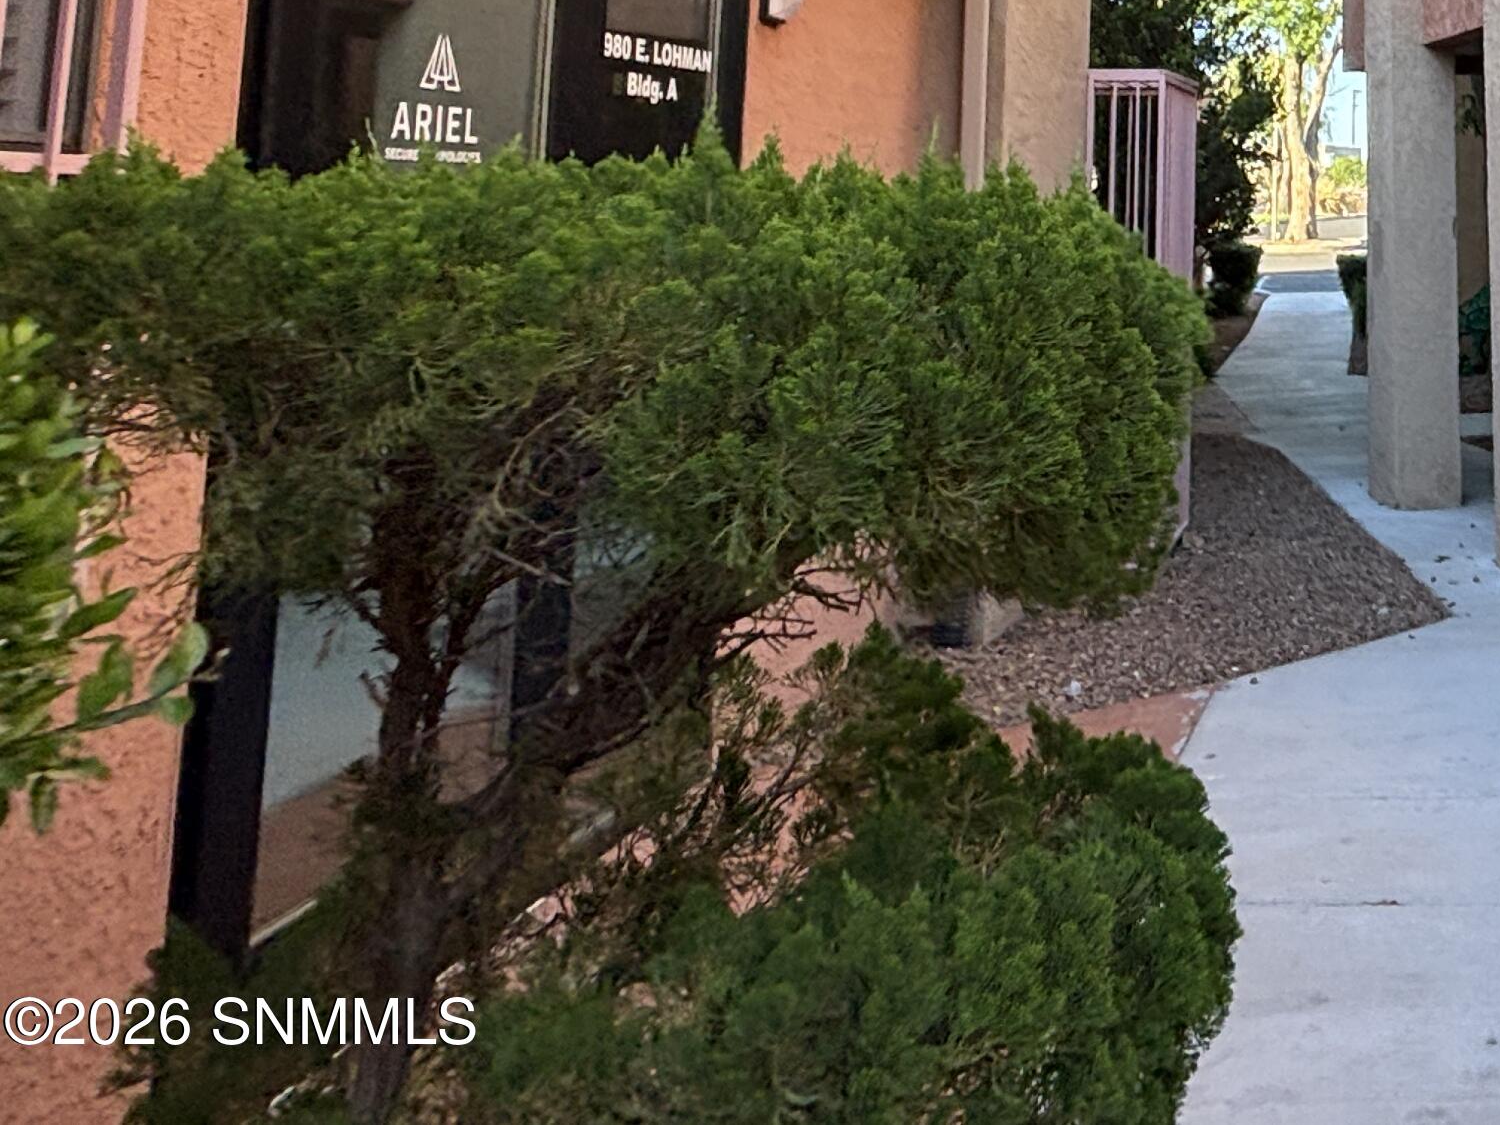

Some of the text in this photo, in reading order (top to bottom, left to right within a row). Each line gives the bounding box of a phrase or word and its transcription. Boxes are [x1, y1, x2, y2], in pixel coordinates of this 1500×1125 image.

[603, 32, 713, 73] 980 E. LOHMAN
[627, 72, 678, 104] Bldg. A
[391, 101, 479, 144] ARIEL
